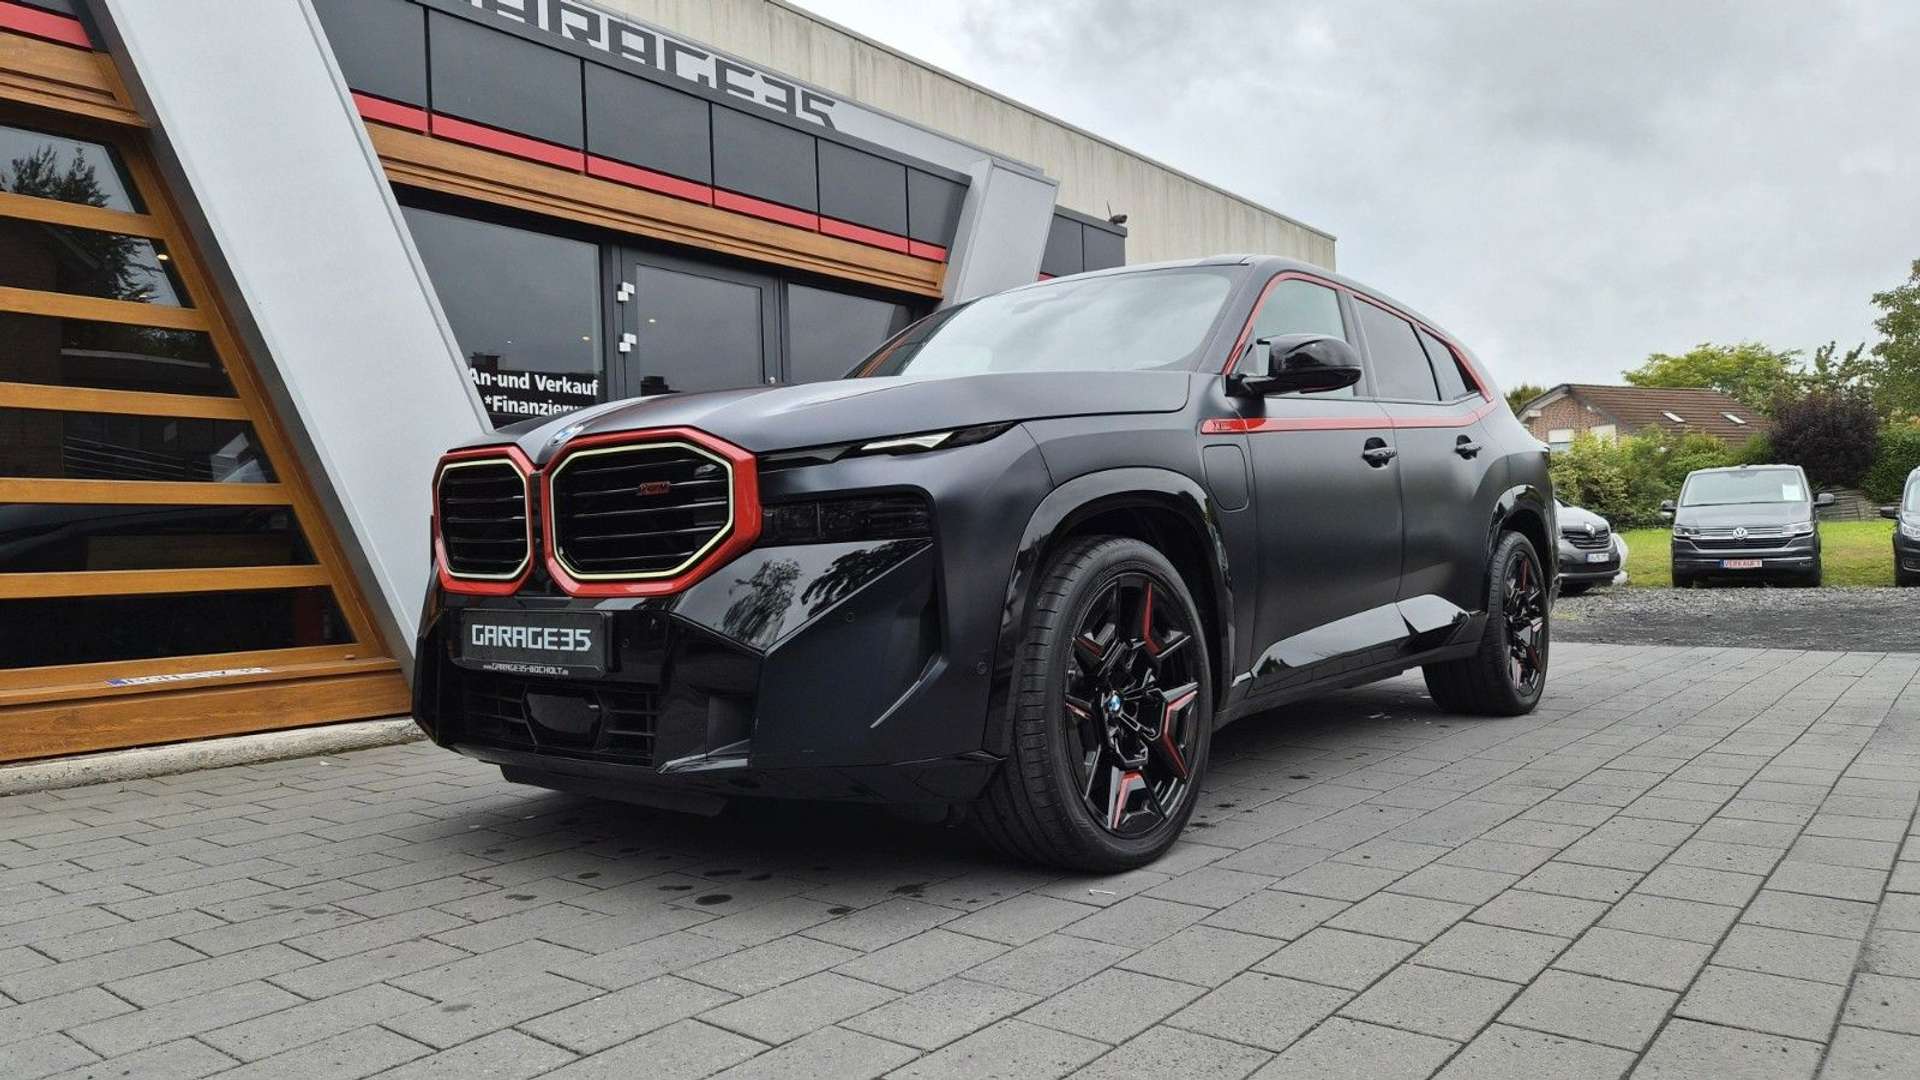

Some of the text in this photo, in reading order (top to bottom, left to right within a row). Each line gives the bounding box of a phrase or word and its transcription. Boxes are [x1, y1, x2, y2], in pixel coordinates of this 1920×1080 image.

[470, 0, 836, 129] ARAGE35
[468, 368, 599, 396] An-und Verkauf
[471, 624, 592, 651] GARAGE35
